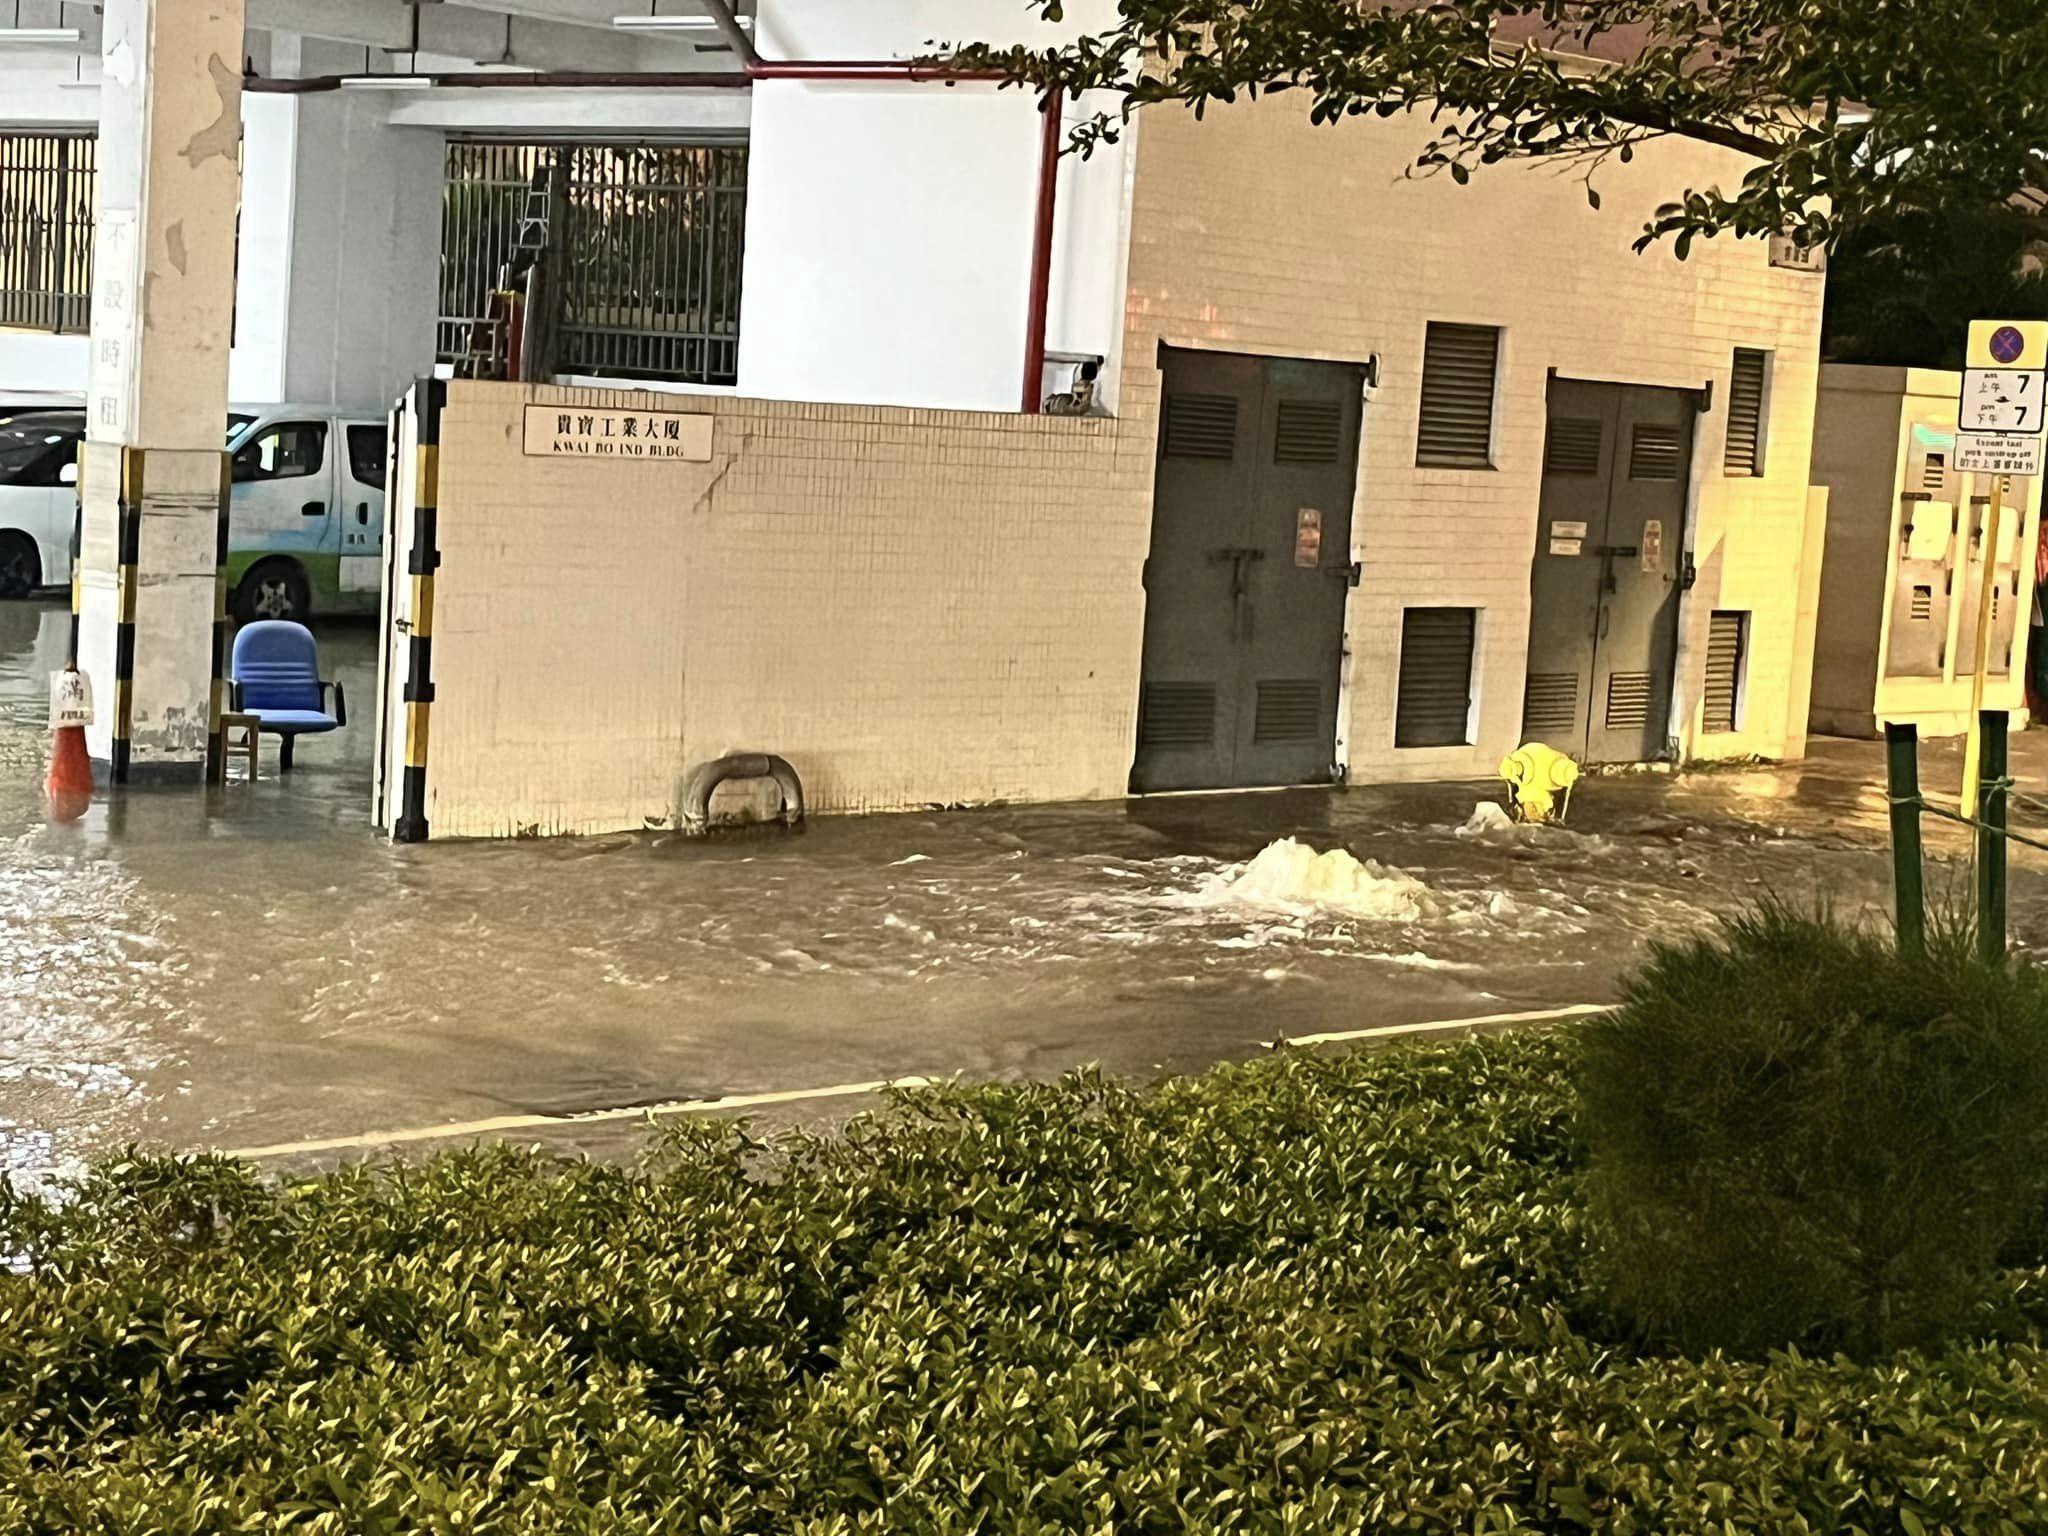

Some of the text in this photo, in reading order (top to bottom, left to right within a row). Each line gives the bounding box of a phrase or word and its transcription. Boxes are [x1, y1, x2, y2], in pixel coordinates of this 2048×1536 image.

[1978, 382, 2001, 394] 上午
[2017, 374, 2030, 394] 7
[1977, 413, 1998, 424] 下午
[2014, 406, 2028, 425] 7
[553, 440, 589, 453] KWAI
[595, 442, 613, 453] BO
[619, 443, 643, 456] IND
